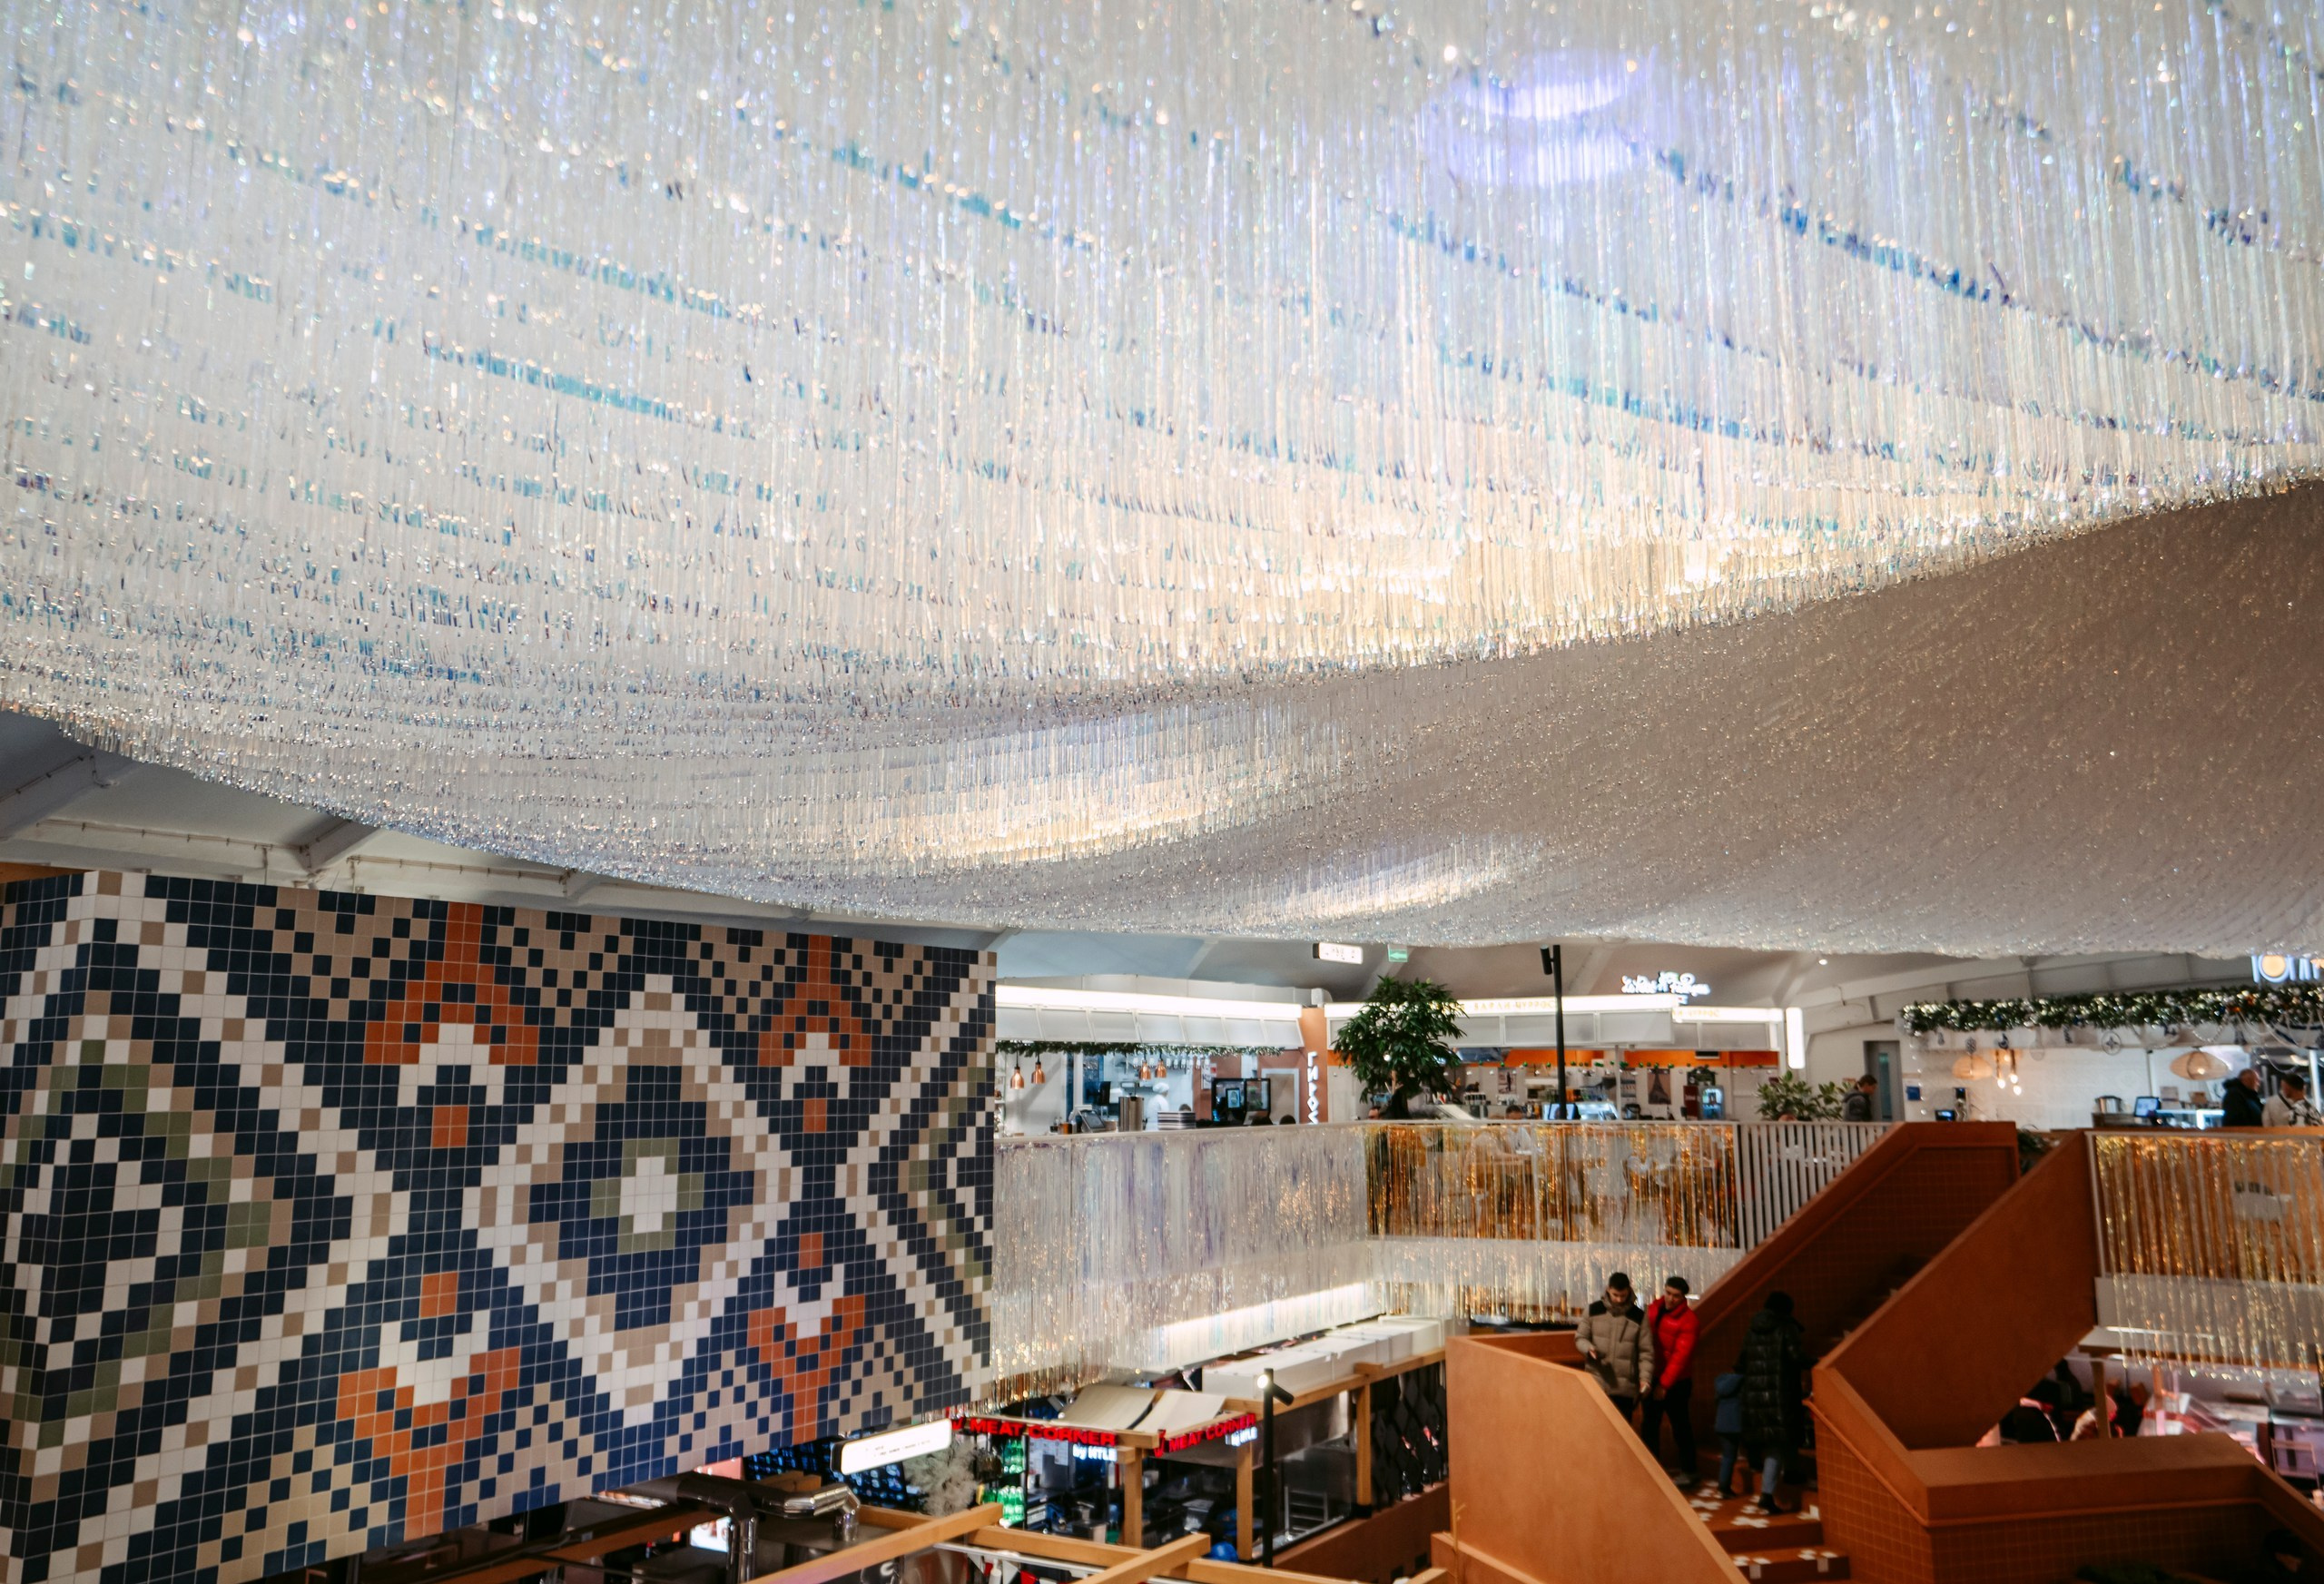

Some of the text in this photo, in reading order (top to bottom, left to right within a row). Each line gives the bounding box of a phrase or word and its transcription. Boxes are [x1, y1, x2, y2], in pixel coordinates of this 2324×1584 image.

[1307, 1051, 1319, 1125] ГИРОС
[970, 1417, 1117, 1447] MEAT CORNER
[1169, 1412, 1256, 1453] MEAT CORNER
[1073, 1443, 1088, 1461] by
